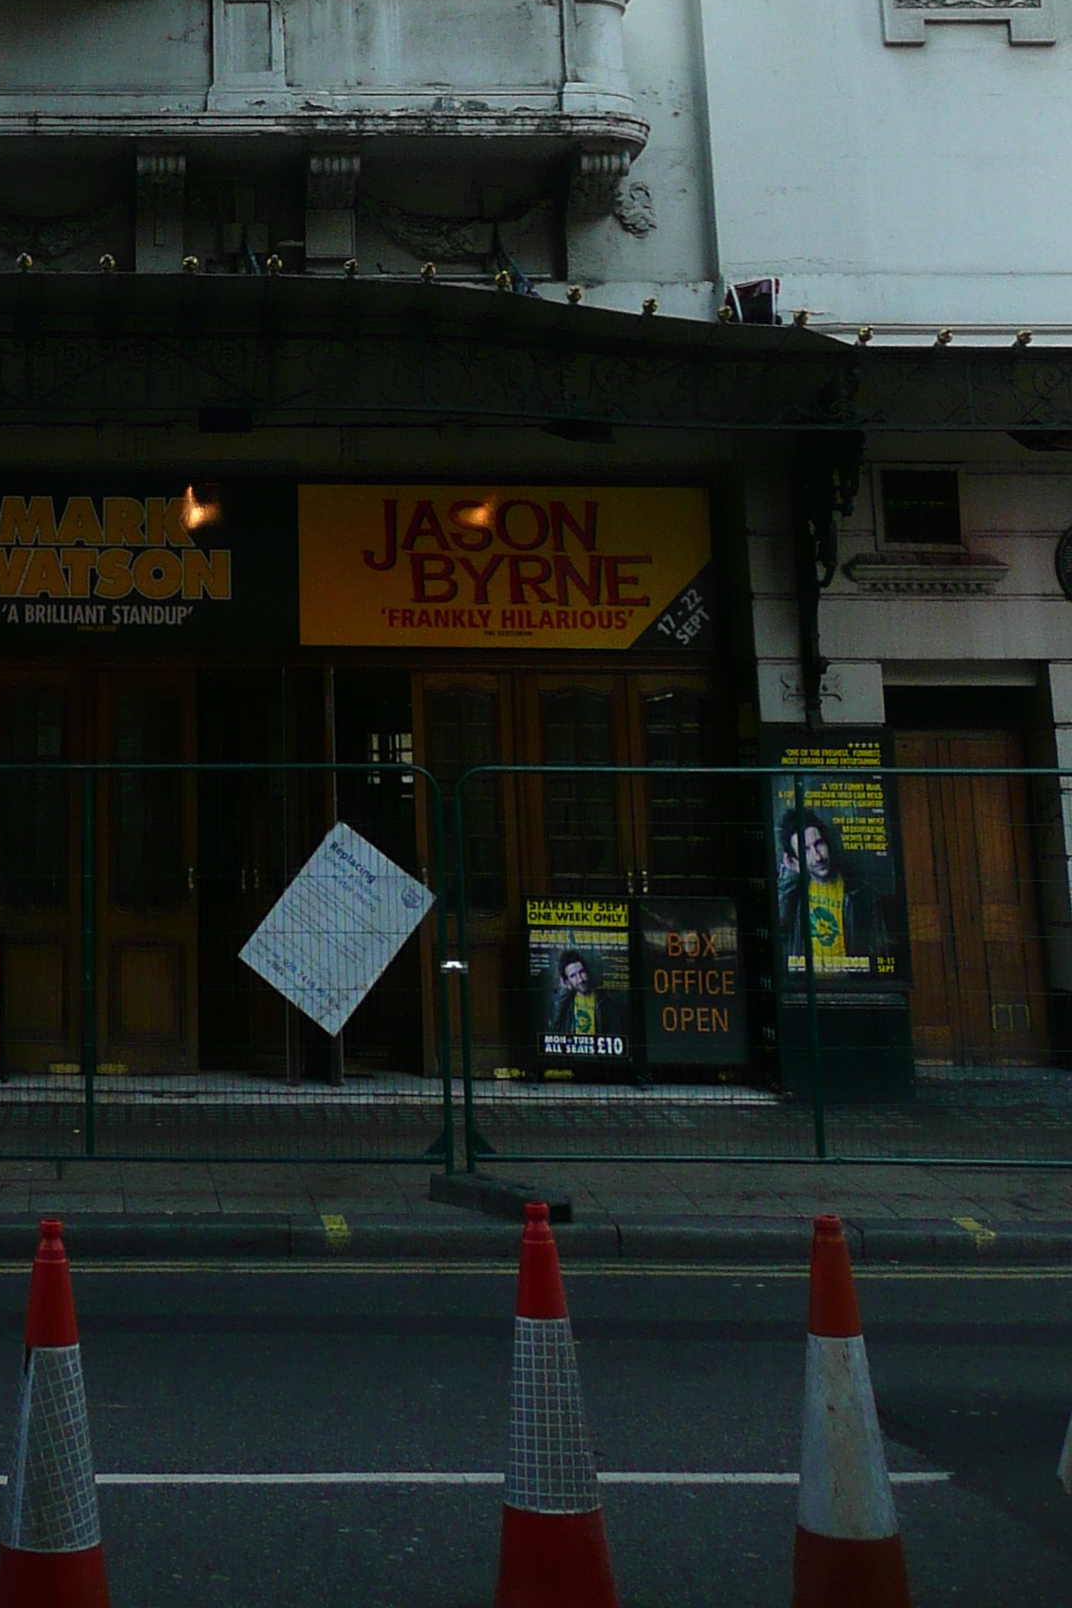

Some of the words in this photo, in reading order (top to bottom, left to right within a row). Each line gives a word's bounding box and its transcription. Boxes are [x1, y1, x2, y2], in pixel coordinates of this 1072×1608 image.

[360, 498, 598, 571] JASON
[407, 552, 653, 607] BYRNE
[23, 604, 106, 625] BRILLIANT
[381, 608, 493, 630] 'FRANKLY
[501, 608, 635, 631] HILARIOUS'
[656, 613, 679, 638] 17
[680, 588, 704, 611] 22
[674, 607, 709, 646] SEPT
[330, 841, 377, 884] Replacing
[529, 901, 574, 911] STARTS
[581, 902, 593, 911] 10
[599, 902, 628, 912] SEPT
[529, 912, 552, 921] ONE
[556, 912, 589, 922] WEEK
[594, 913, 628, 923] ONLY!
[667, 932, 719, 958] BOX
[653, 969, 736, 996] OFFICE
[662, 1006, 729, 1033] OPEN
[545, 1044, 562, 1053] ALL
[565, 1044, 595, 1054] SEATS
[596, 1036, 624, 1055] £10
